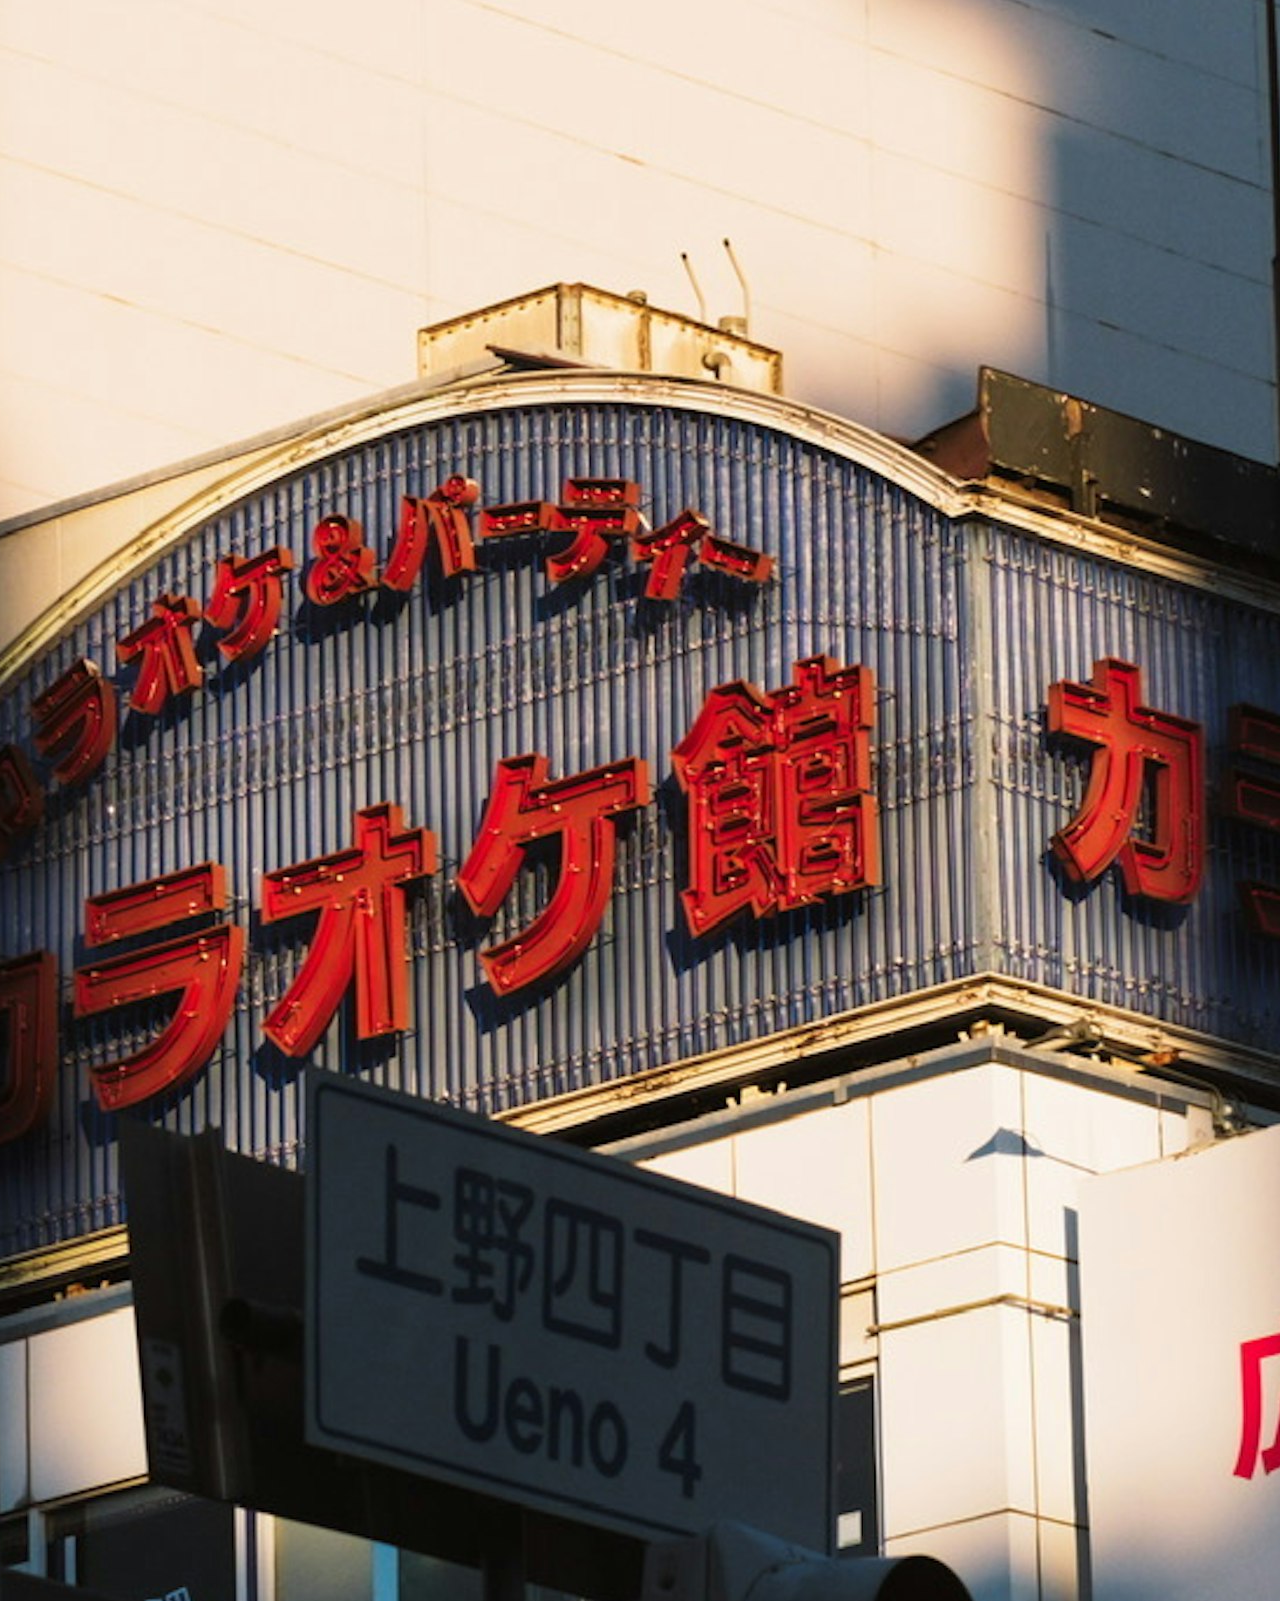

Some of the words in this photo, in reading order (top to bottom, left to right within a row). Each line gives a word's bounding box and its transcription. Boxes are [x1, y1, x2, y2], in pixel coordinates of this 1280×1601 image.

[356, 1144, 792, 1402] 上野四丁目
[454, 1335, 629, 1479] Ueno
[657, 1401, 702, 1500] 4
